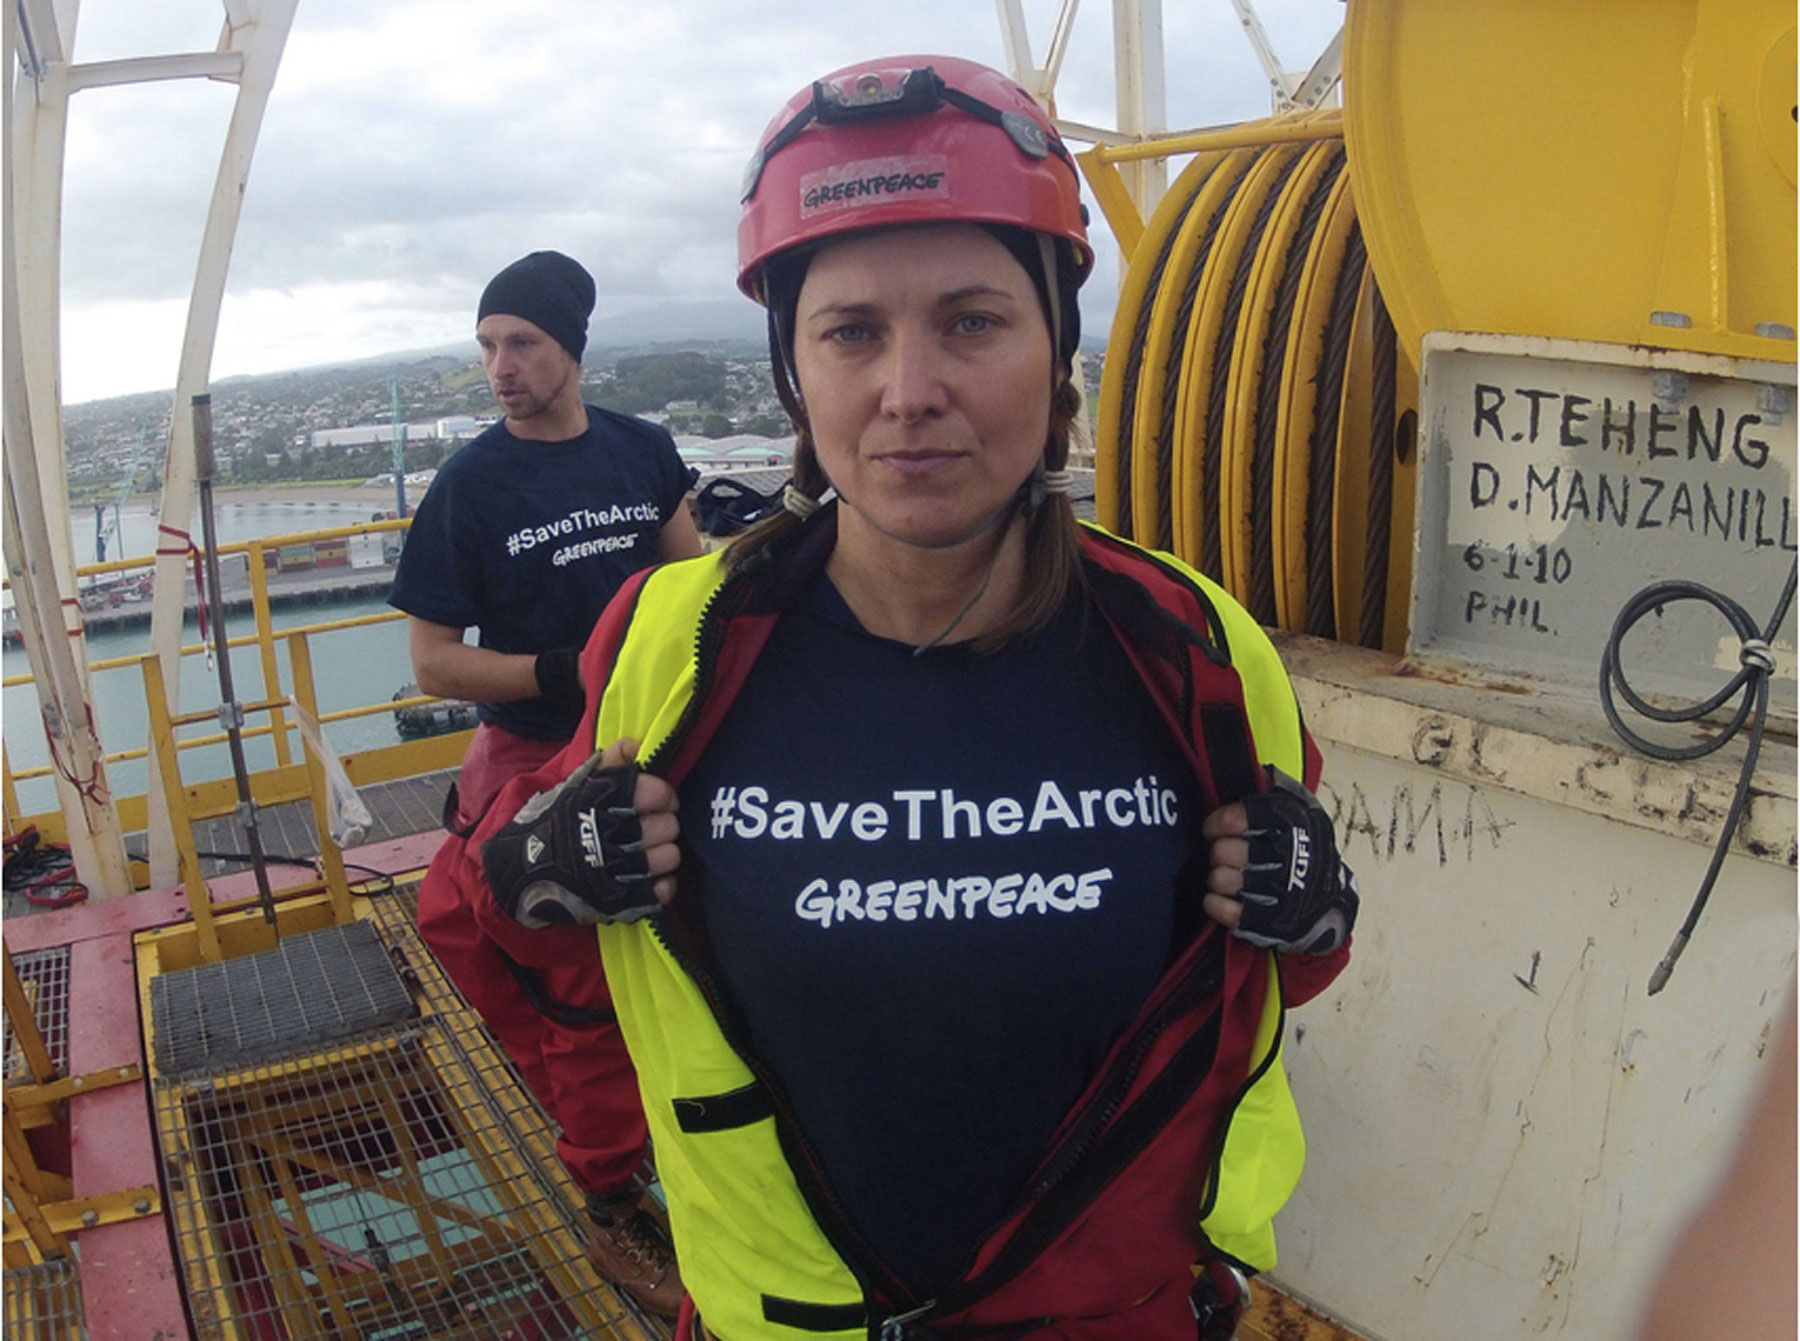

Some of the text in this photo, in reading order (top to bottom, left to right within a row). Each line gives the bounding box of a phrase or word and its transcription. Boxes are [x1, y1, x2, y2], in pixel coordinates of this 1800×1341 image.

[803, 172, 945, 208] GREENPEACE
[1473, 383, 1769, 469] R.TEHENG
[506, 502, 660, 556] #SaveTheArctic
[552, 533, 639, 567] GREENPEACE
[578, 807, 604, 868] TUFF
[711, 775, 1178, 840] #SaveTheArctic
[1287, 826, 1311, 892] TUFF
[795, 868, 1113, 928] GREENPEACE
